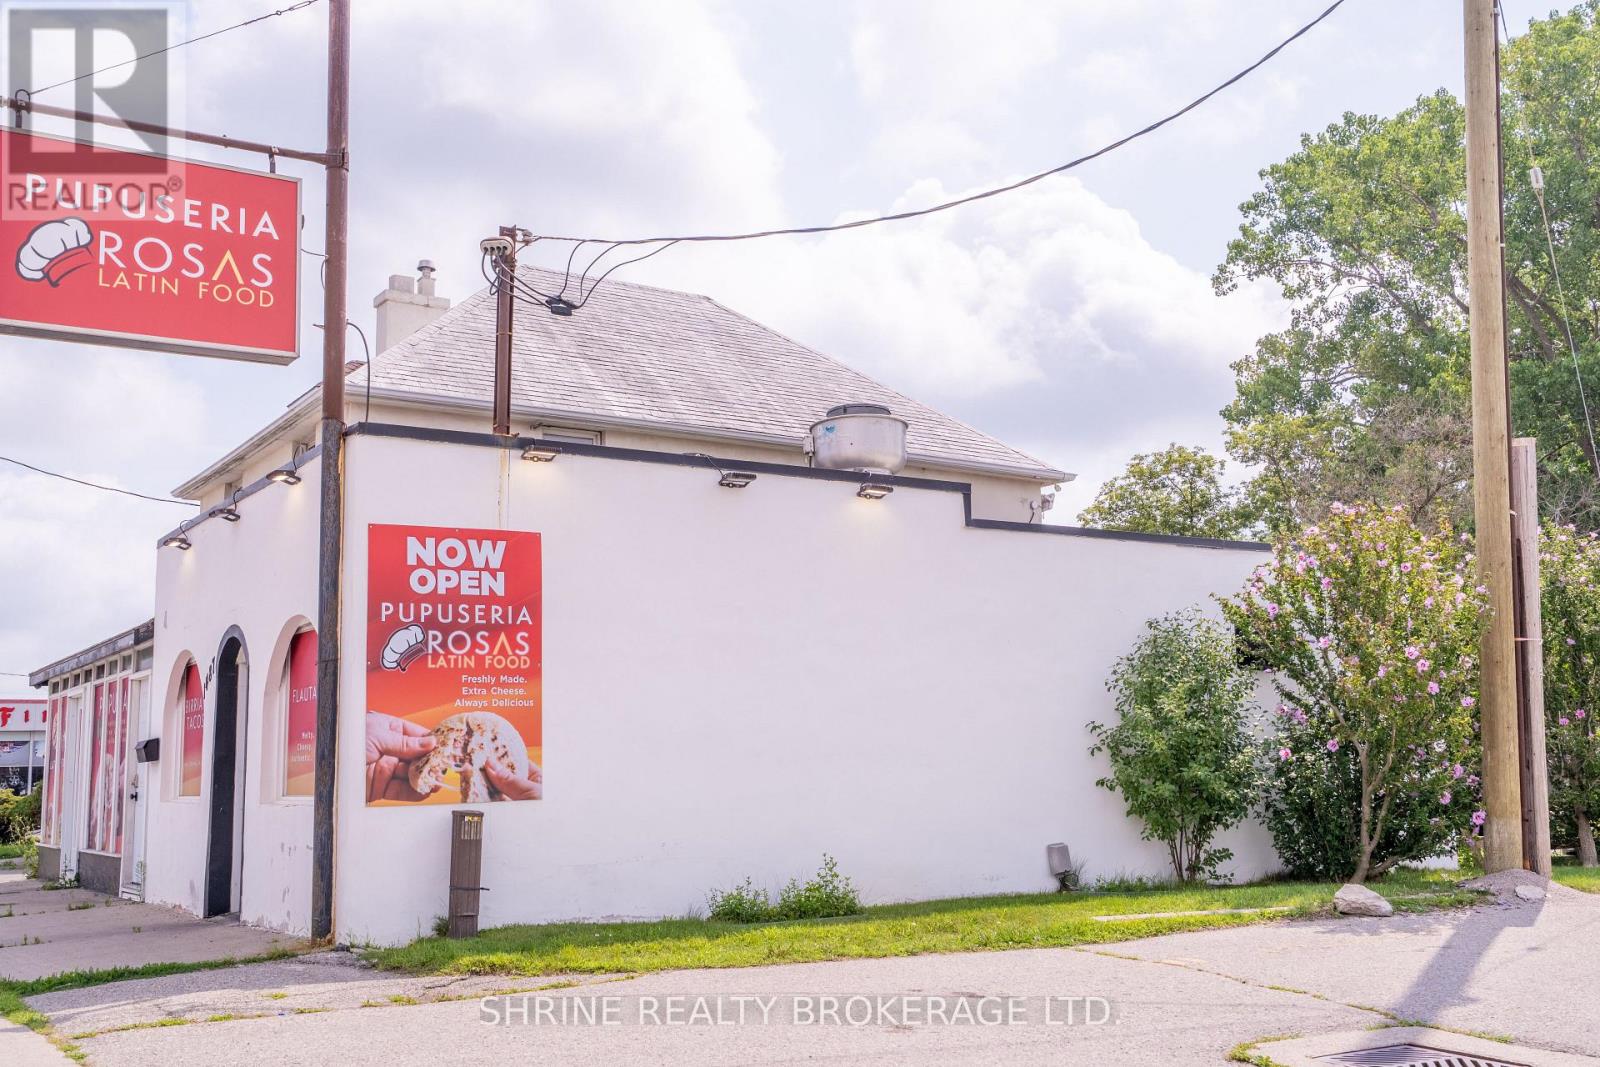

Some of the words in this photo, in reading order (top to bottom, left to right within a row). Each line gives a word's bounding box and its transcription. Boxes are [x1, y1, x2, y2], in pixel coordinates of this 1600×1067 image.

[25, 173, 280, 240] PUPUSERIA
[98, 268, 179, 296] LATIN
[199, 282, 274, 308] FOOD
[406, 536, 507, 569] NOW
[409, 568, 505, 597] OPEN
[380, 602, 533, 625] PUPUSERIA
[427, 655, 475, 669] LATIN
[485, 655, 531, 669] FOOD
[462, 675, 496, 684] Freshly
[500, 675, 528, 683] Made.
[462, 687, 487, 695] Extra
[491, 687, 527, 695] Cheese.
[454, 698, 488, 708] Always
[492, 698, 534, 707] Delicious
